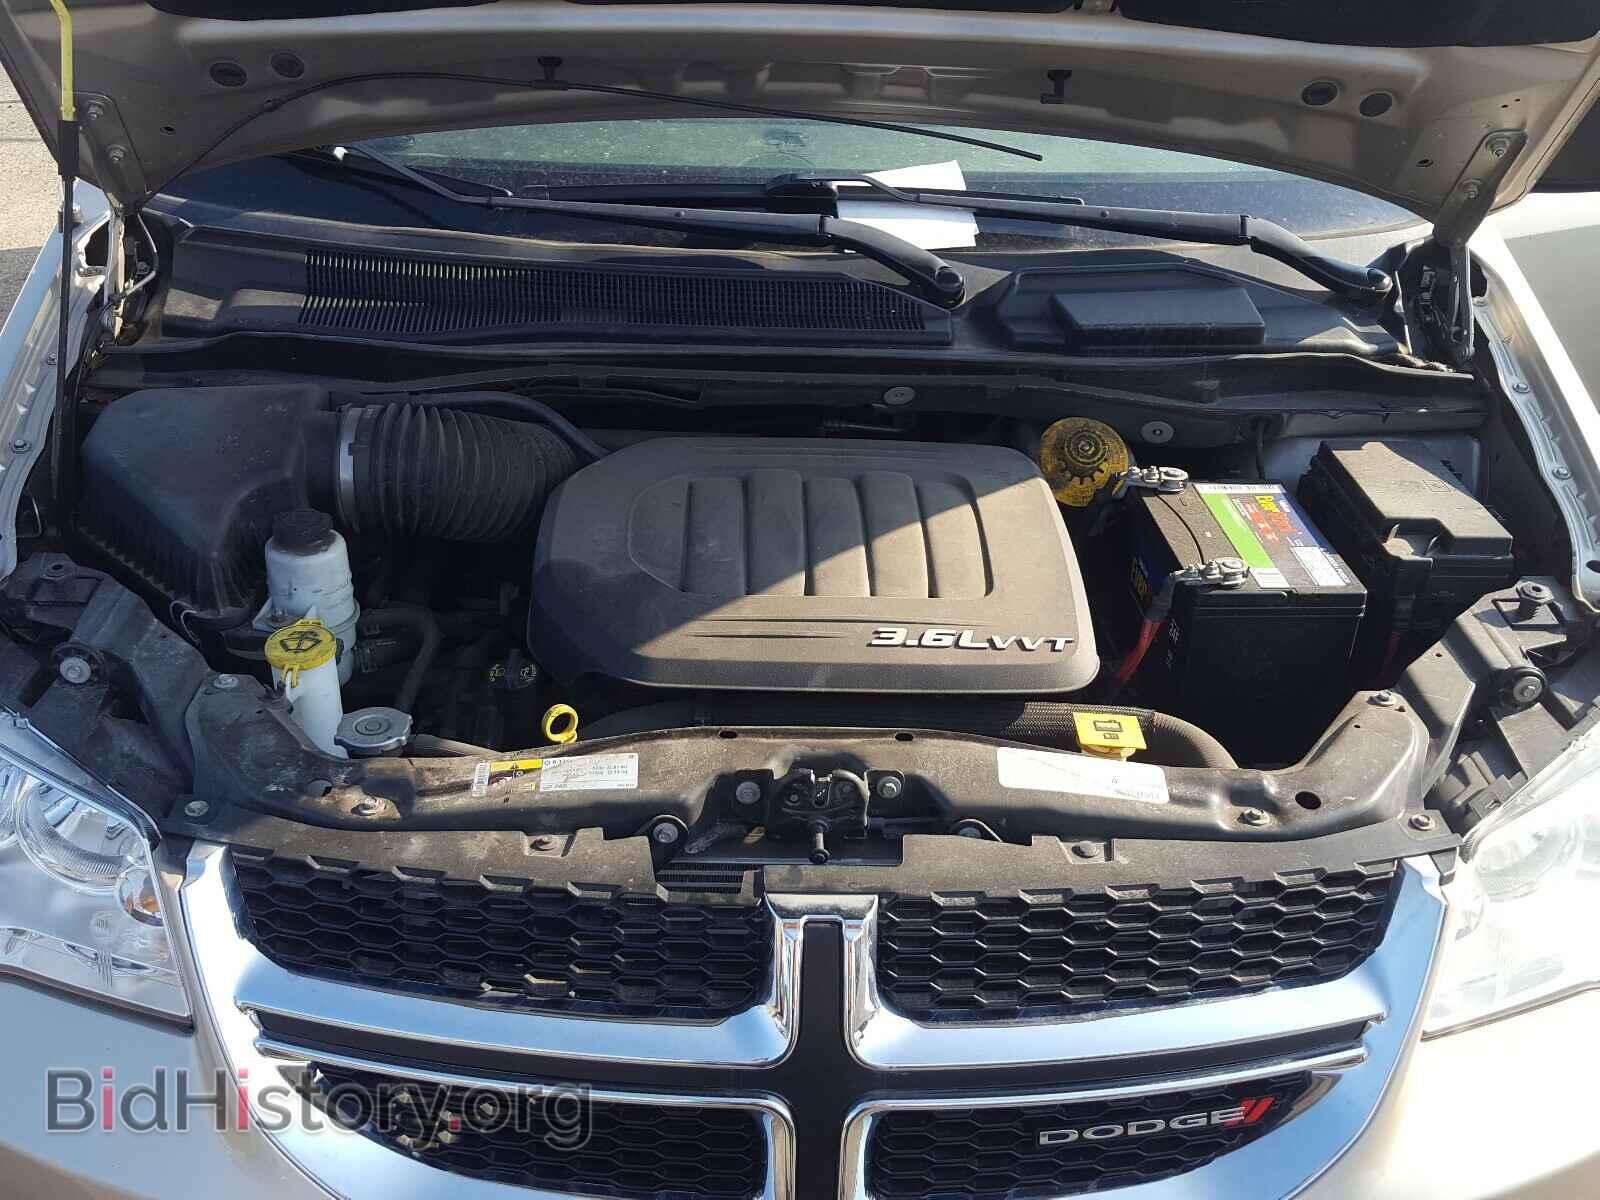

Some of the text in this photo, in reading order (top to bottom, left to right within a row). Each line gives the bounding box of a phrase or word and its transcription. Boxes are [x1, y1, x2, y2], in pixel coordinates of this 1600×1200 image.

[867, 627, 1075, 652] 3.6L VVT
[1039, 1106, 1246, 1146] DODGE
